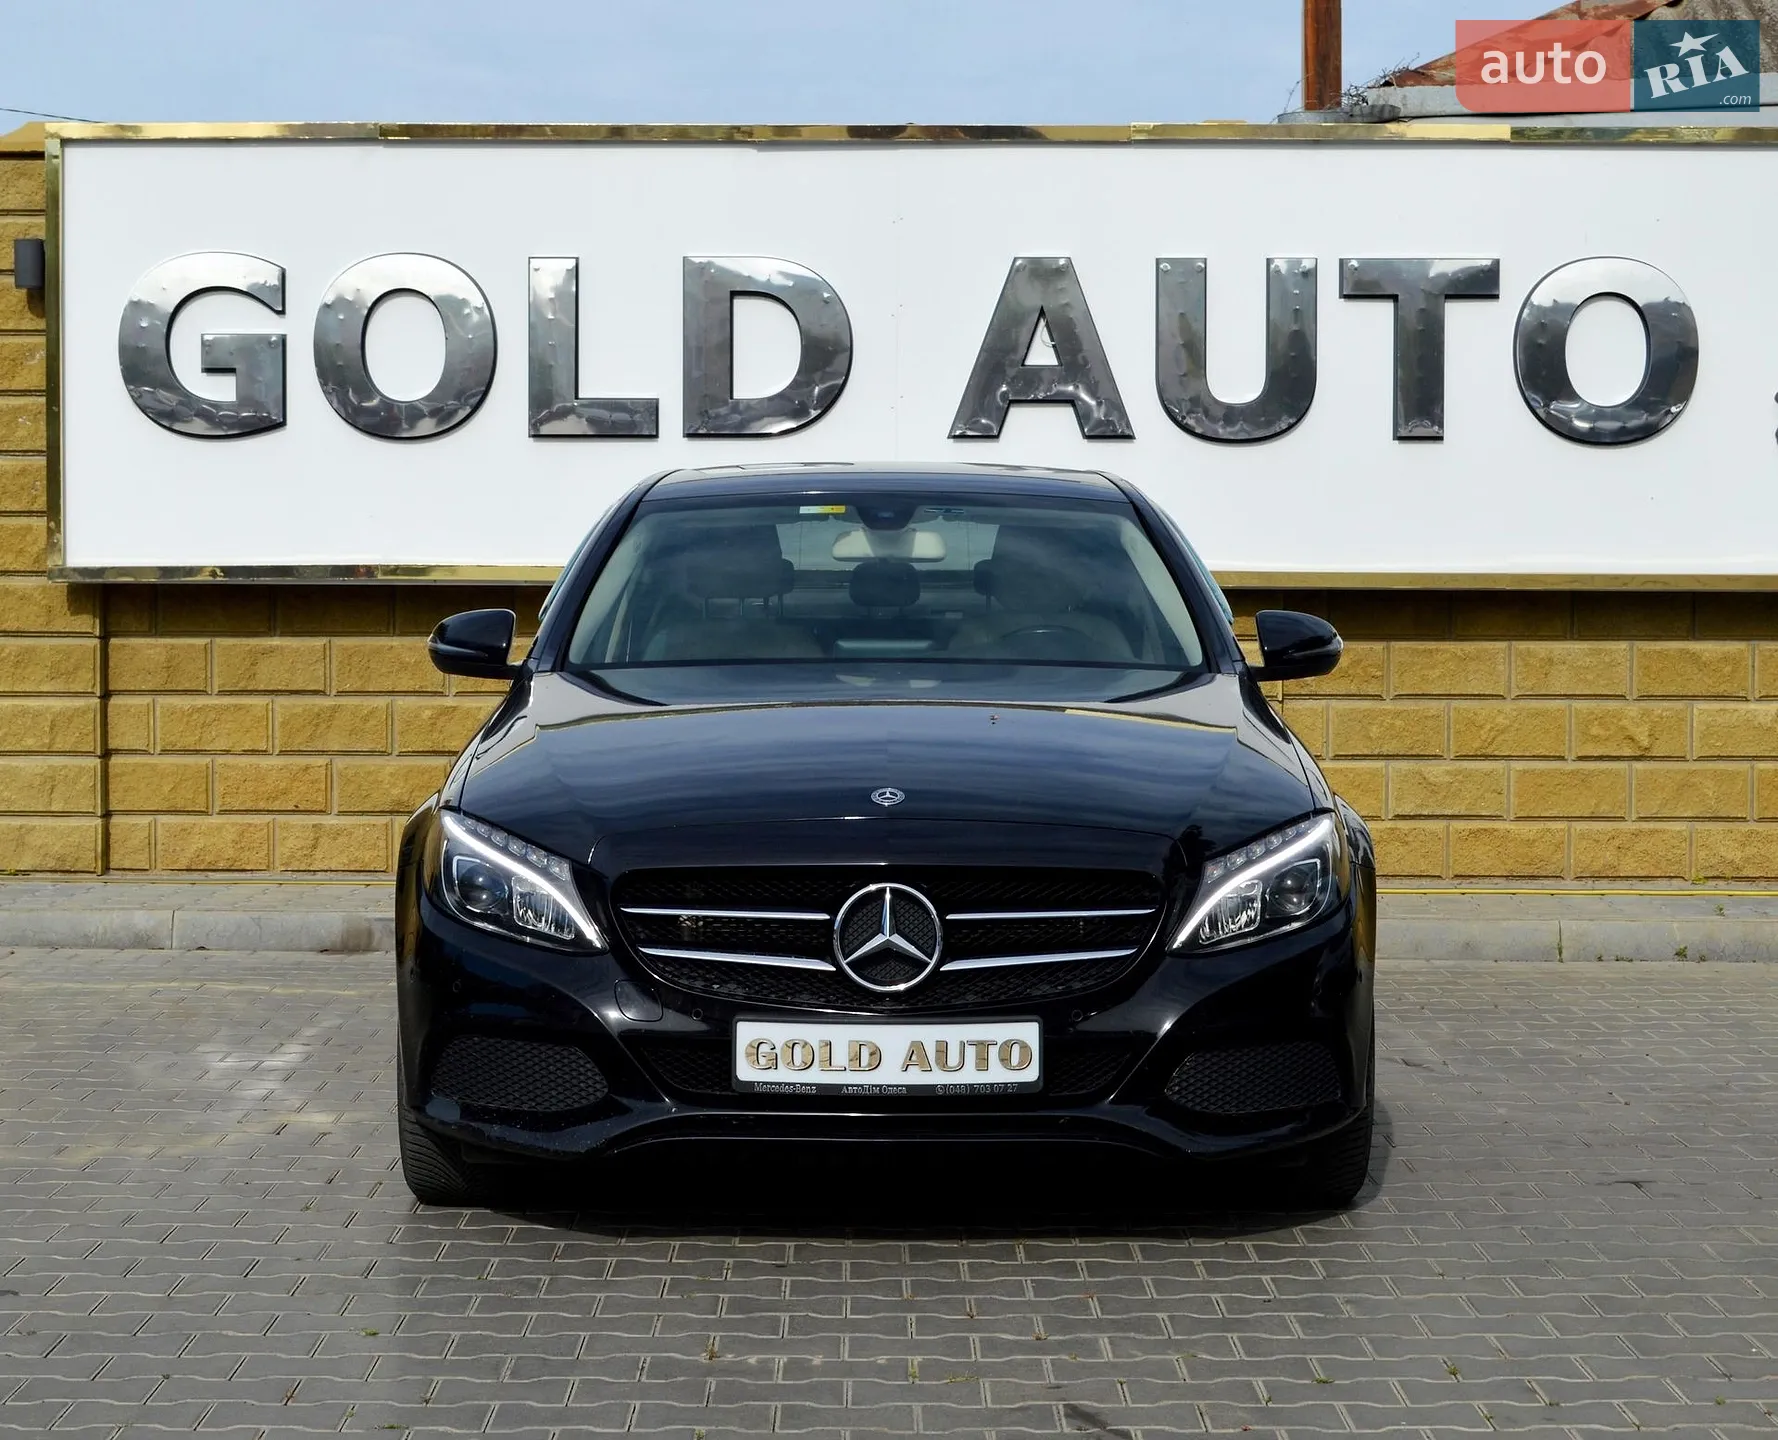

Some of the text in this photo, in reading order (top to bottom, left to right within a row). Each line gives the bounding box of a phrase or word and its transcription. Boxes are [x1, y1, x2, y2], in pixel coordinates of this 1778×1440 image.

[118, 251, 1700, 445] GOLD AUTO
[744, 1037, 1033, 1072] GOLD AUTO
[754, 1082, 817, 1094] Mercedes-Benz
[973, 1084, 991, 1093] 703
[993, 1084, 1005, 1093] 07
[1007, 1083, 1018, 1092] 27
